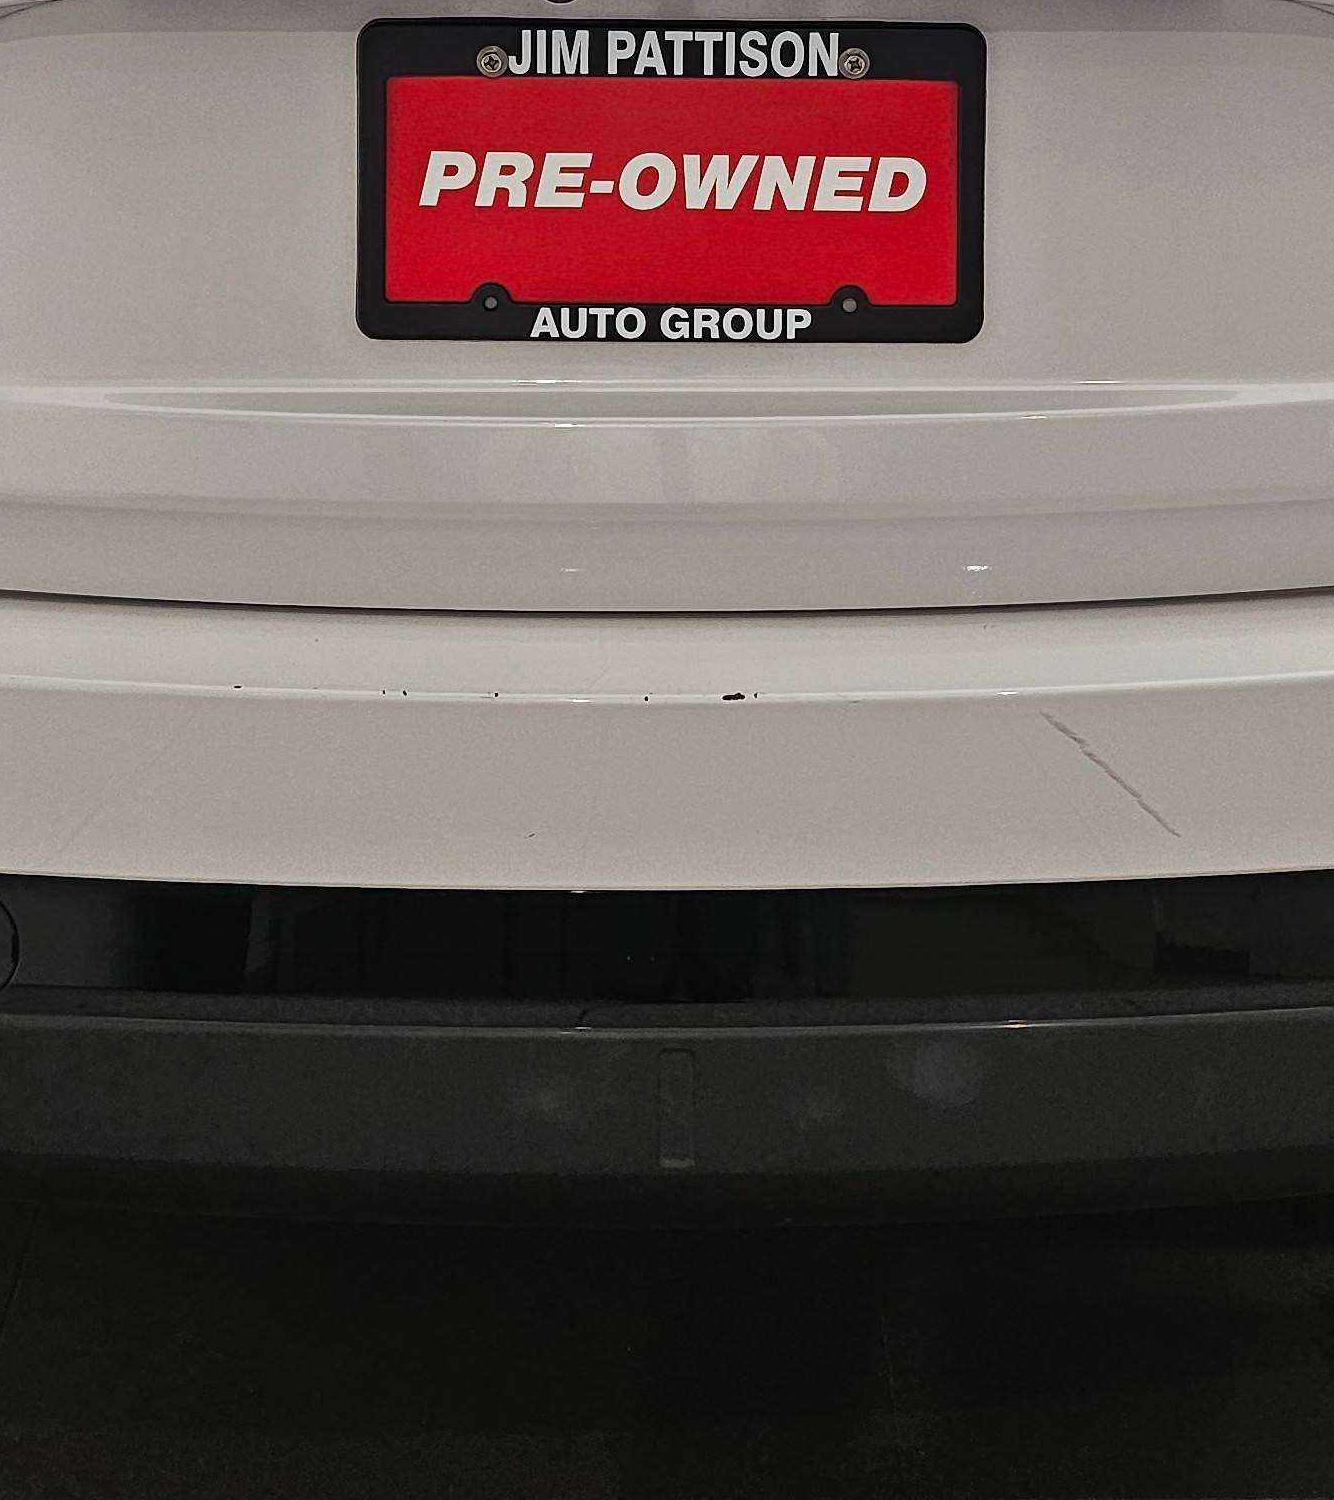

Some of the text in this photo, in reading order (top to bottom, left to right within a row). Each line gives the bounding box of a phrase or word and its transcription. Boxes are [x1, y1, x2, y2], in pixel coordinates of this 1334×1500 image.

[507, 29, 840, 77] JIM PATTISON
[418, 150, 928, 213] PRE-OWNED
[530, 307, 813, 340] AUTO GROUP
